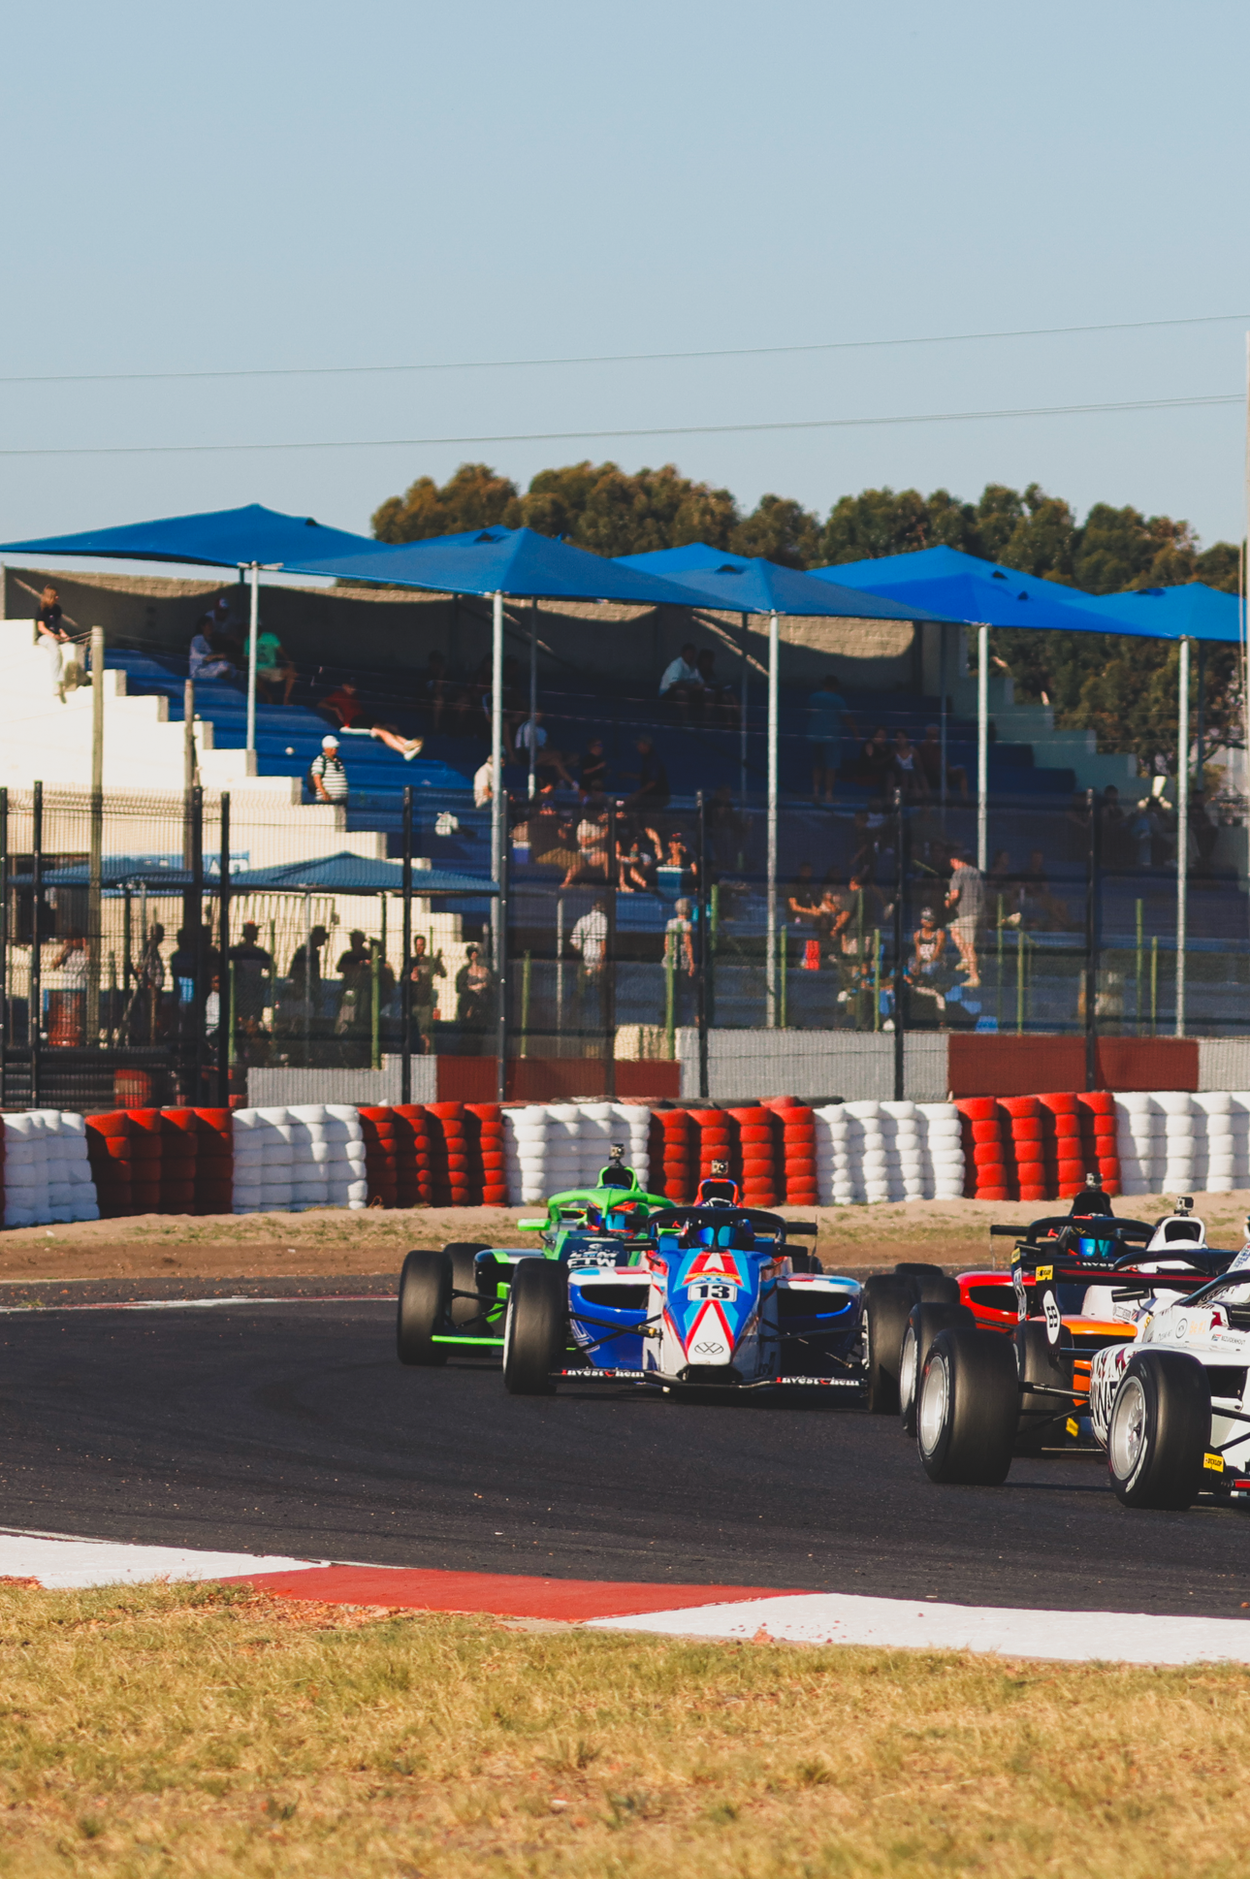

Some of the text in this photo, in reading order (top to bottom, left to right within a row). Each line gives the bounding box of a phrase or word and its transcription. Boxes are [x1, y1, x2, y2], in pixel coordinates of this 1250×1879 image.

[695, 1284, 730, 1299] 13
[561, 1367, 645, 1378] InvestChem
[776, 1376, 860, 1386] InvestChem
